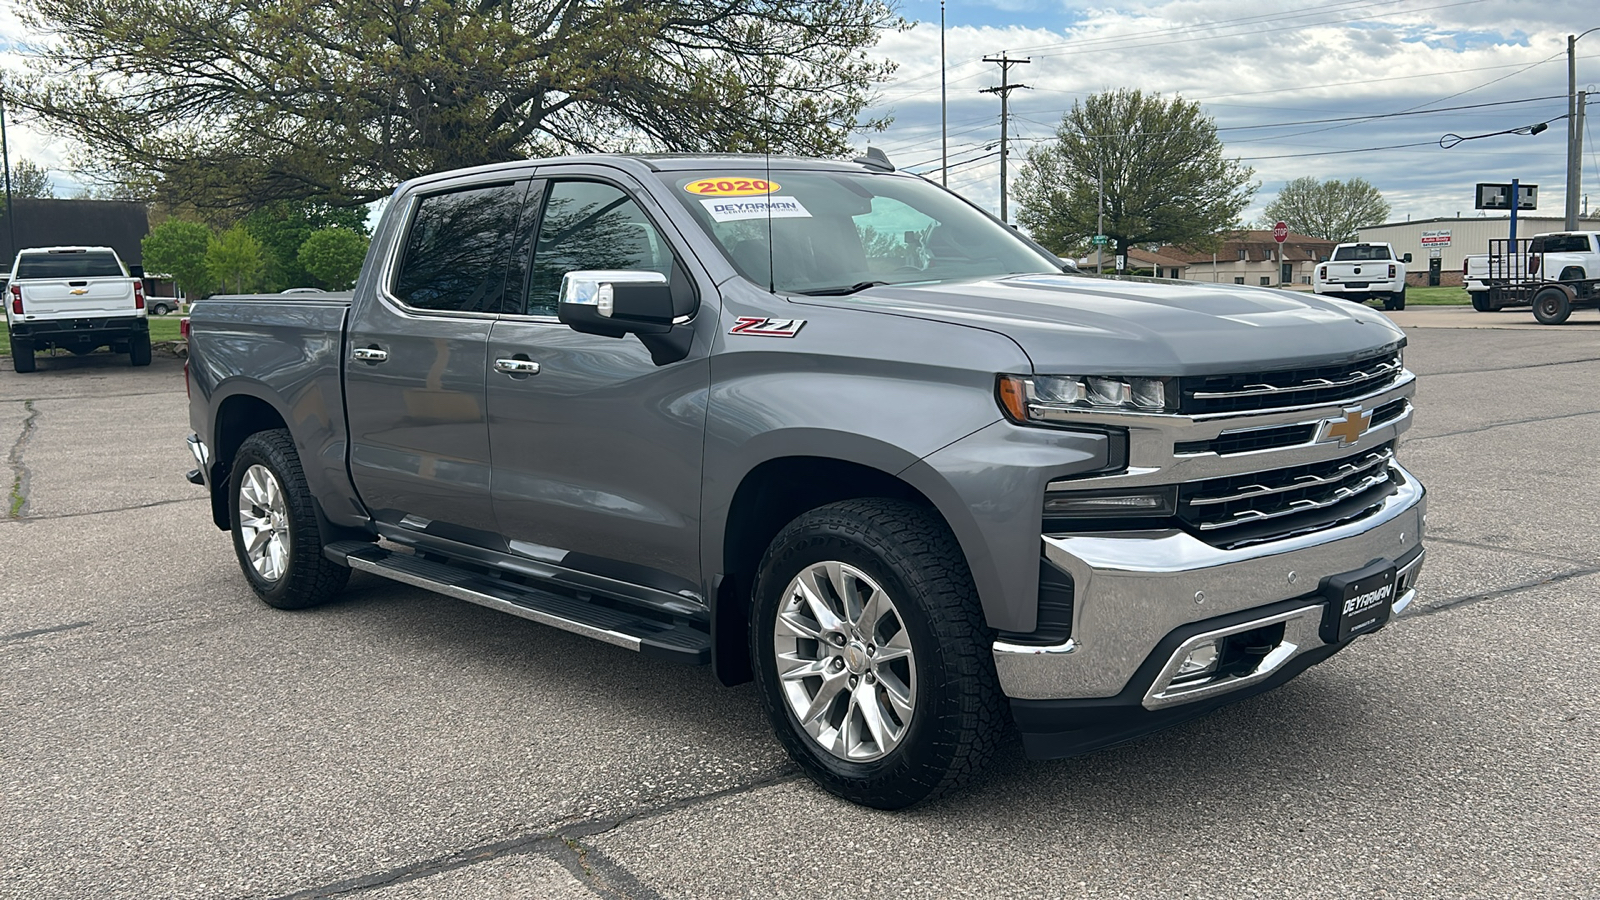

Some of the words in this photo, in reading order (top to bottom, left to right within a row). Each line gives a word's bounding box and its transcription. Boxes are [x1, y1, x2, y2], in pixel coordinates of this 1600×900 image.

[697, 181, 769, 193] 2020
[714, 202, 797, 212] DEYARMAN
[1274, 227, 1288, 237] STOP
[728, 316, 807, 338] Z71
[1342, 584, 1393, 615] DEYARMAN
